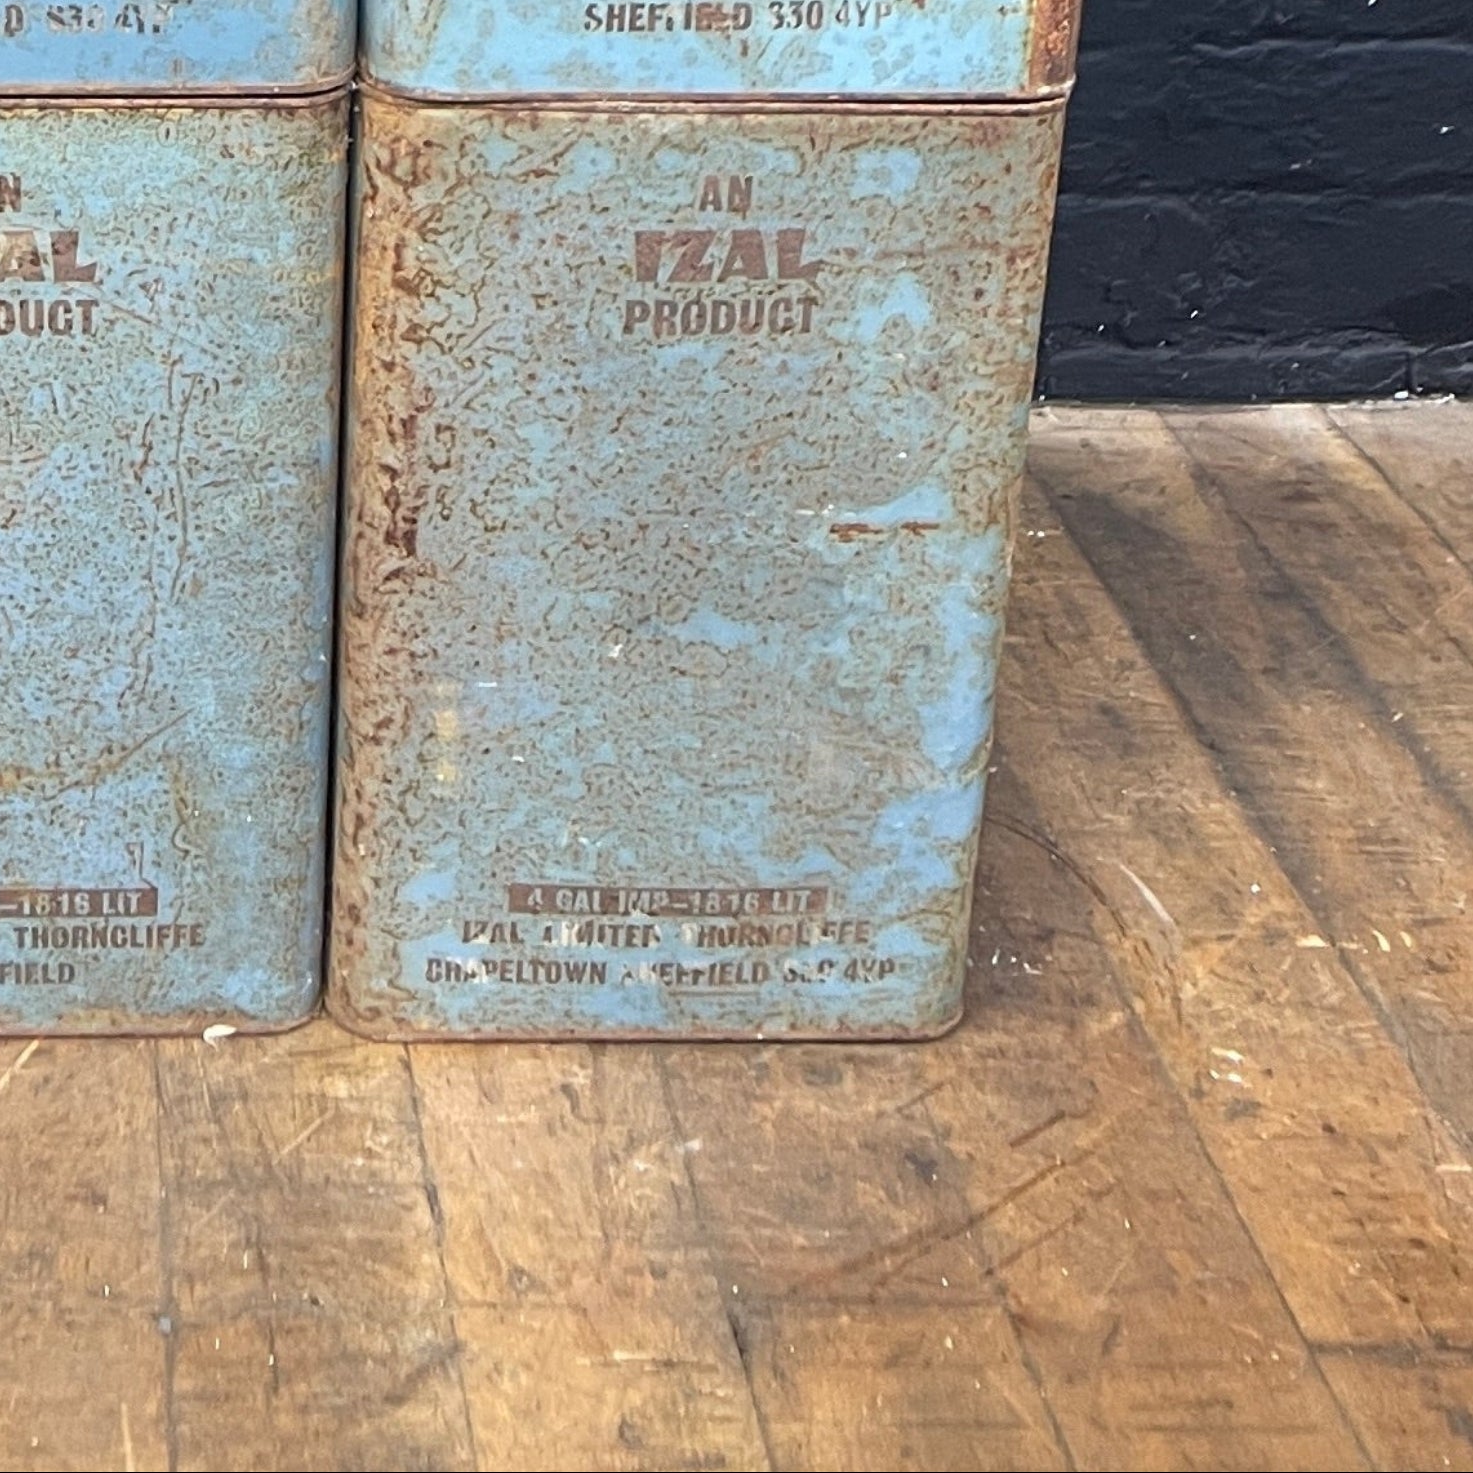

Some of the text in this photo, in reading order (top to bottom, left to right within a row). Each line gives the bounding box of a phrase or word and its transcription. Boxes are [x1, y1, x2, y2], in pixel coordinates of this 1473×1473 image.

[835, 0, 891, 30] 4YP
[699, 176, 753, 212] AN
[635, 230, 825, 282] IZAL
[623, 297, 817, 336] PRODUCT
[103, 892, 142, 915] LIT
[528, 888, 543, 909] 4
[556, 889, 603, 913] GAL
[772, 890, 811, 912] LIT
[14, 924, 207, 948] THORNCLIFFE
[462, 921, 524, 944] IZAL
[542, 920, 661, 947] LIMITED
[426, 958, 607, 984] CHAPELTOWN
[844, 957, 895, 983] 4YP
